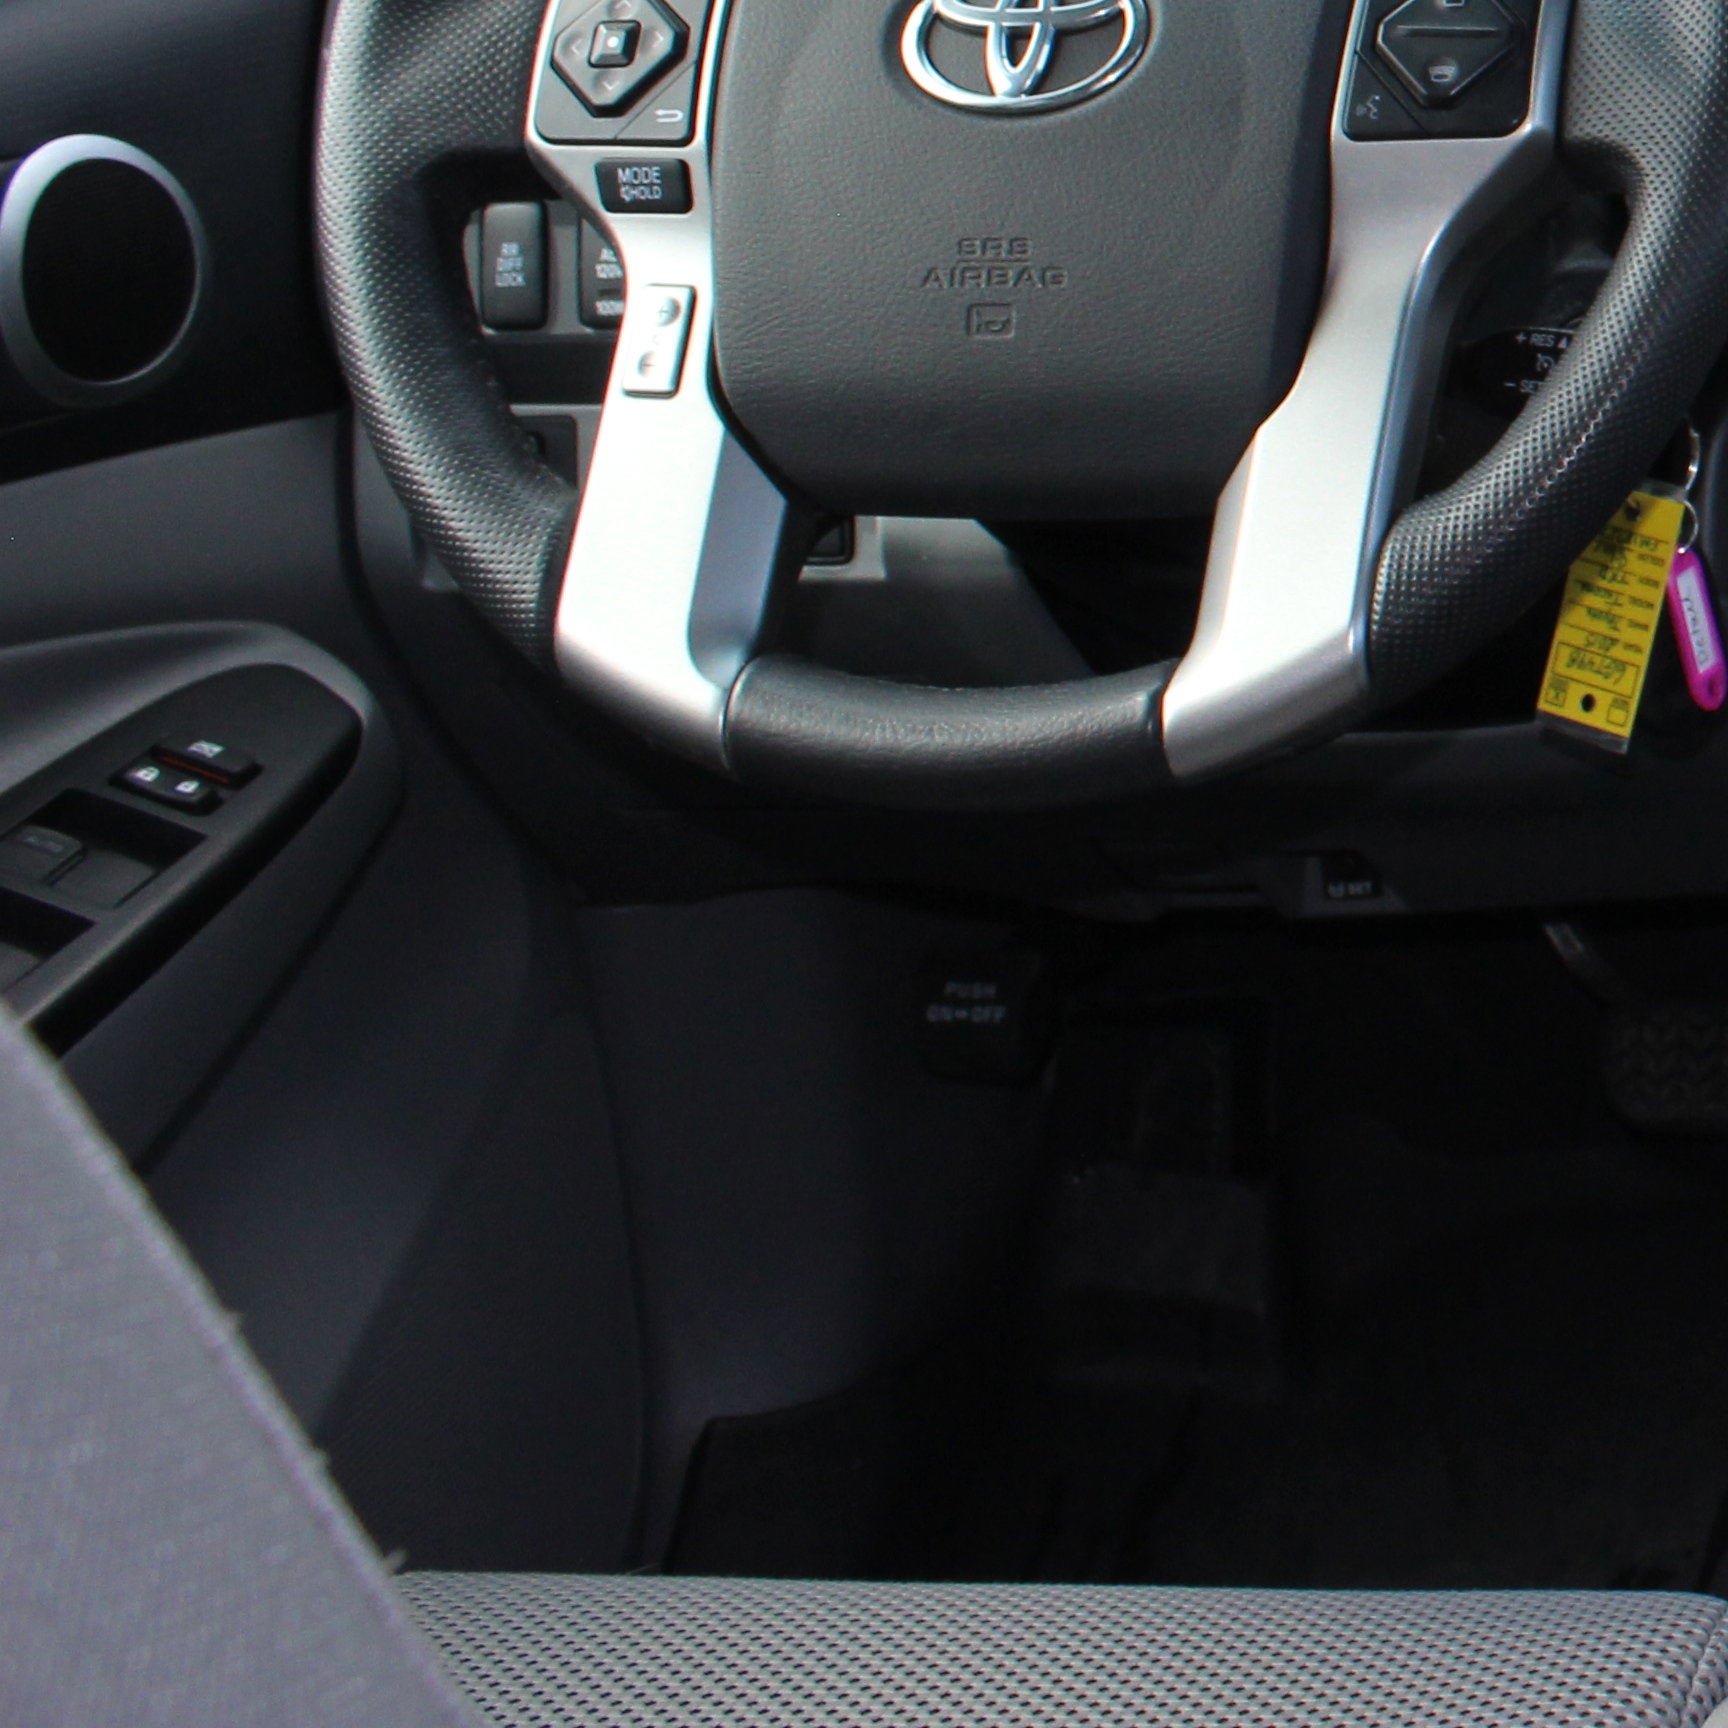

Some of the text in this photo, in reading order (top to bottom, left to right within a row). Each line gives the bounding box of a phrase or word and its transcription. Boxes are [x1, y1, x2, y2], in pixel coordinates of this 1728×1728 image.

[617, 166, 662, 184] MODE
[631, 185, 662, 199] HOLD
[958, 237, 1032, 258] SRS
[495, 272, 526, 287] LOCK
[920, 266, 1068, 288] AIRBAG
